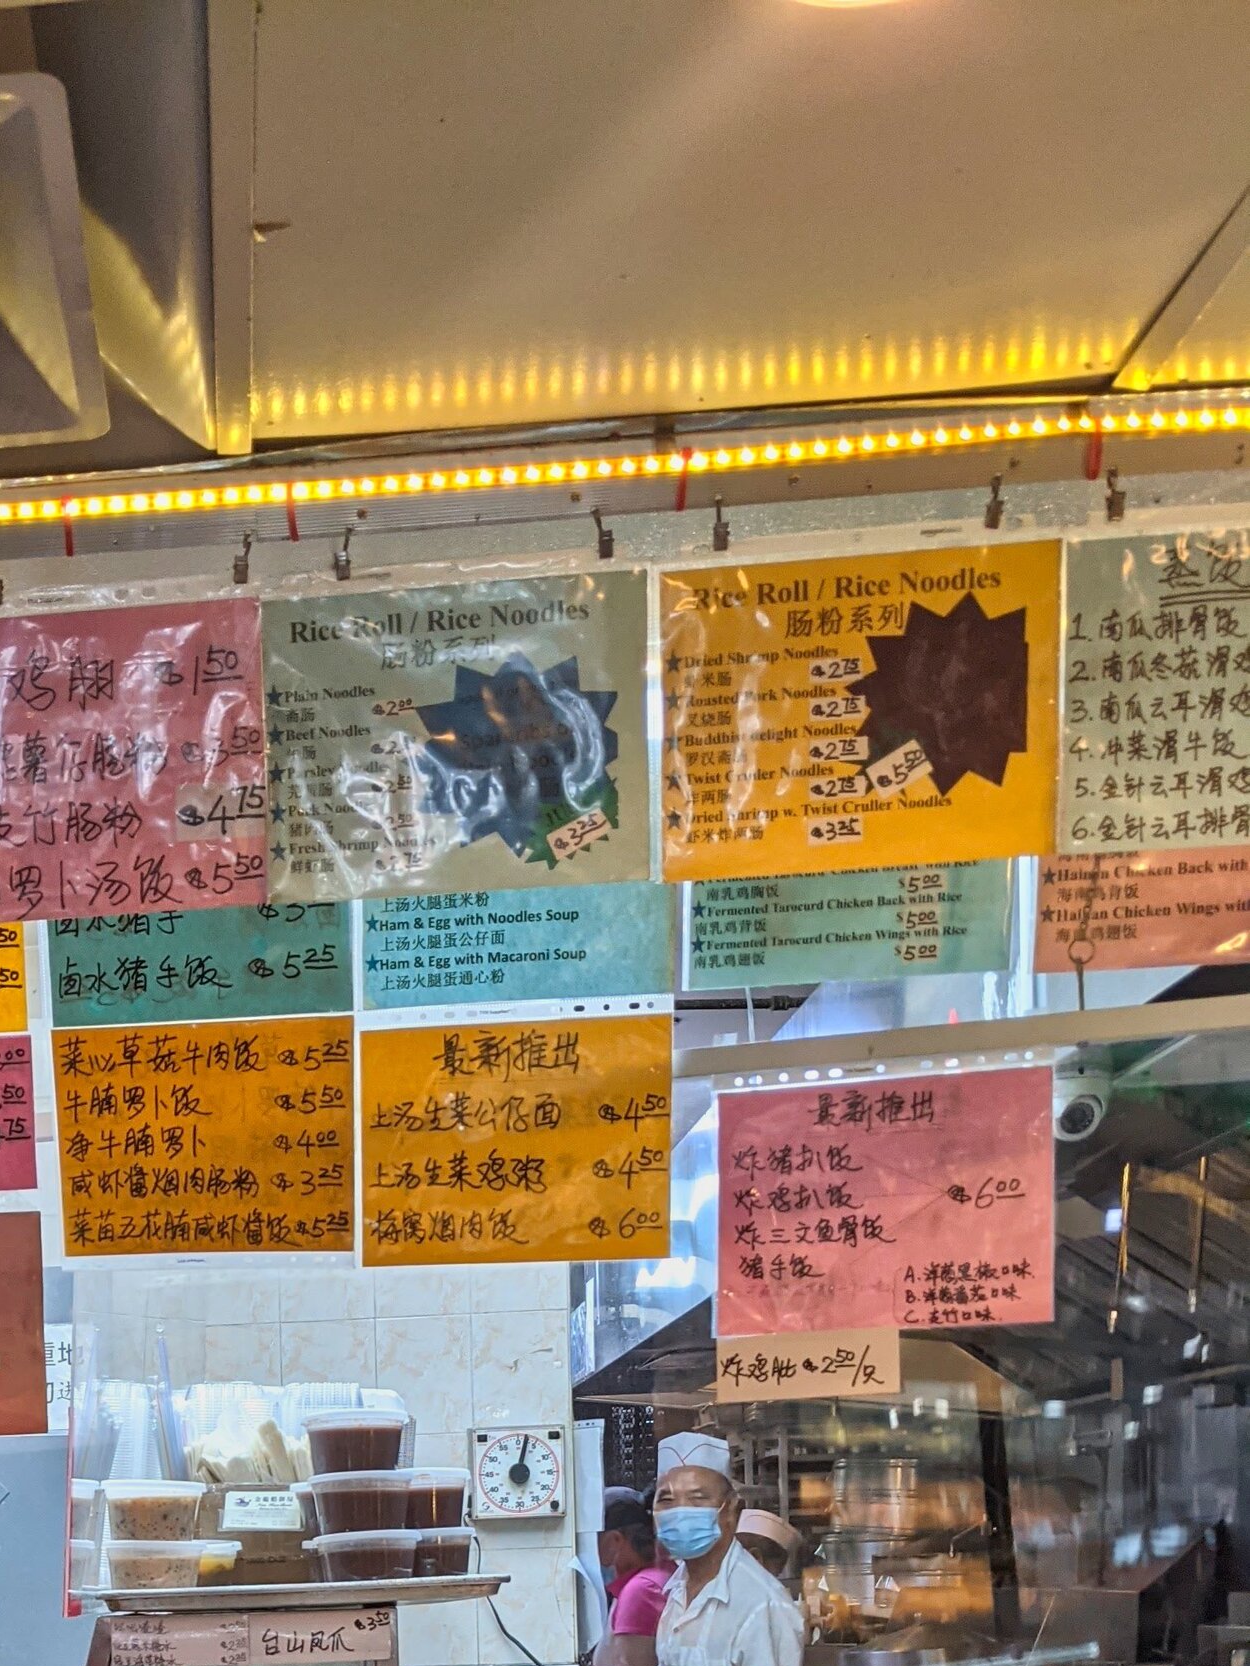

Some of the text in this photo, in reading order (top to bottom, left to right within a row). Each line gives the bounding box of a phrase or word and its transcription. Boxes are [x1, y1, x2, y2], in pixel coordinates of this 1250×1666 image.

[693, 586, 748, 611] Rice
[756, 579, 809, 606] Roll
[834, 575, 891, 599] Rice
[898, 567, 1002, 595] Noodles
[290, 620, 340, 645] Rice
[353, 613, 404, 638] Roll
[427, 609, 482, 634] Rice
[489, 599, 590, 630] Noodles
[784, 601, 906, 639] 肠粉系列
[685, 645, 839, 669] Dried Shrmp Noodles
[284, 685, 376, 704] Plain Noodles
[687, 710, 732, 728] 叉烧肠
[285, 724, 372, 743] Beef Noodles
[1178, 860, 1214, 876] Back
[1218, 858, 1249, 871] with
[382, 891, 490, 913] 上汤火腿蛋米粉
[707, 891, 963, 918] Fermented Tarocurd Chicken Back with Rice
[379, 908, 580, 932] Ham & Egg with Noodles Soup
[380, 929, 505, 953] 上汤火腿蛋公仔面
[706, 924, 968, 951] Fermented Tarocurd Chicken Wings with Rice
[379, 946, 588, 973] Ham & Egg with Macaroni Soup
[380, 968, 505, 992] 上汤火腿蛋通心粉
[433, 1030, 580, 1082] 最新推出
[807, 1090, 934, 1132] 最新推出
